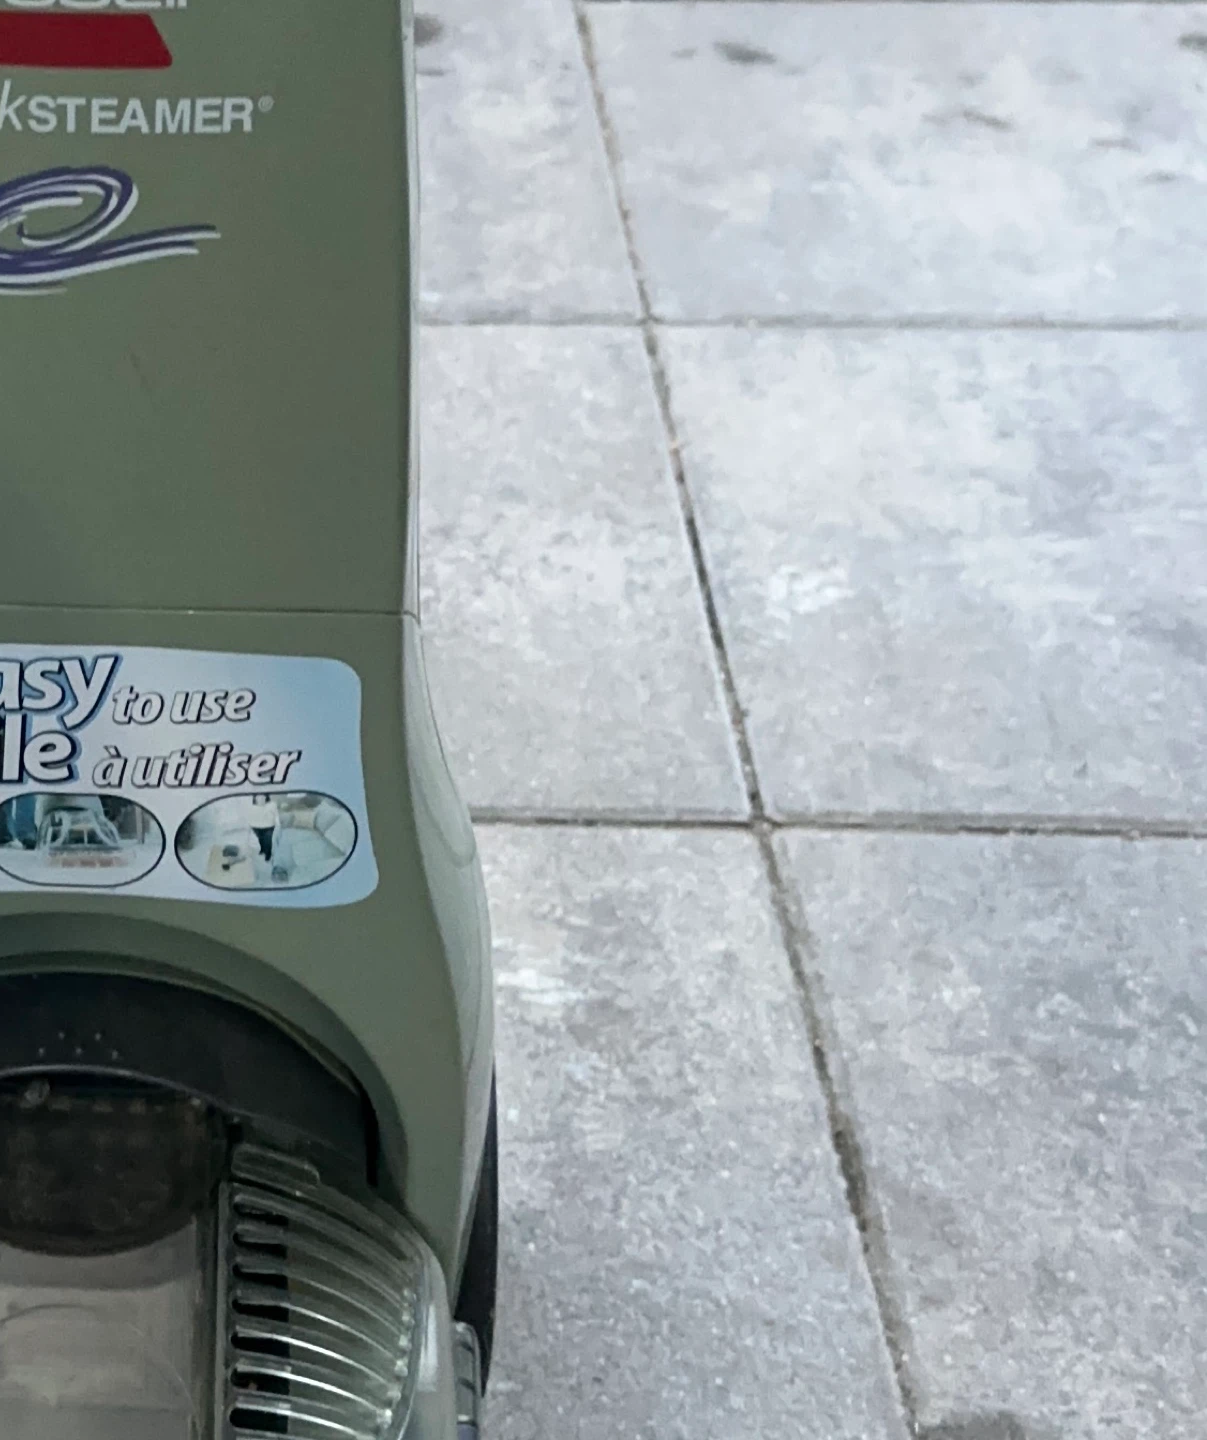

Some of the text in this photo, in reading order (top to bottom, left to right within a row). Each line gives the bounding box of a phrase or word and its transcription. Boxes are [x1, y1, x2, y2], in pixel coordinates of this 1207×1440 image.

[112, 685, 165, 725] to
[169, 688, 257, 724] use
[92, 744, 128, 789] à
[130, 740, 302, 789] utiliser
